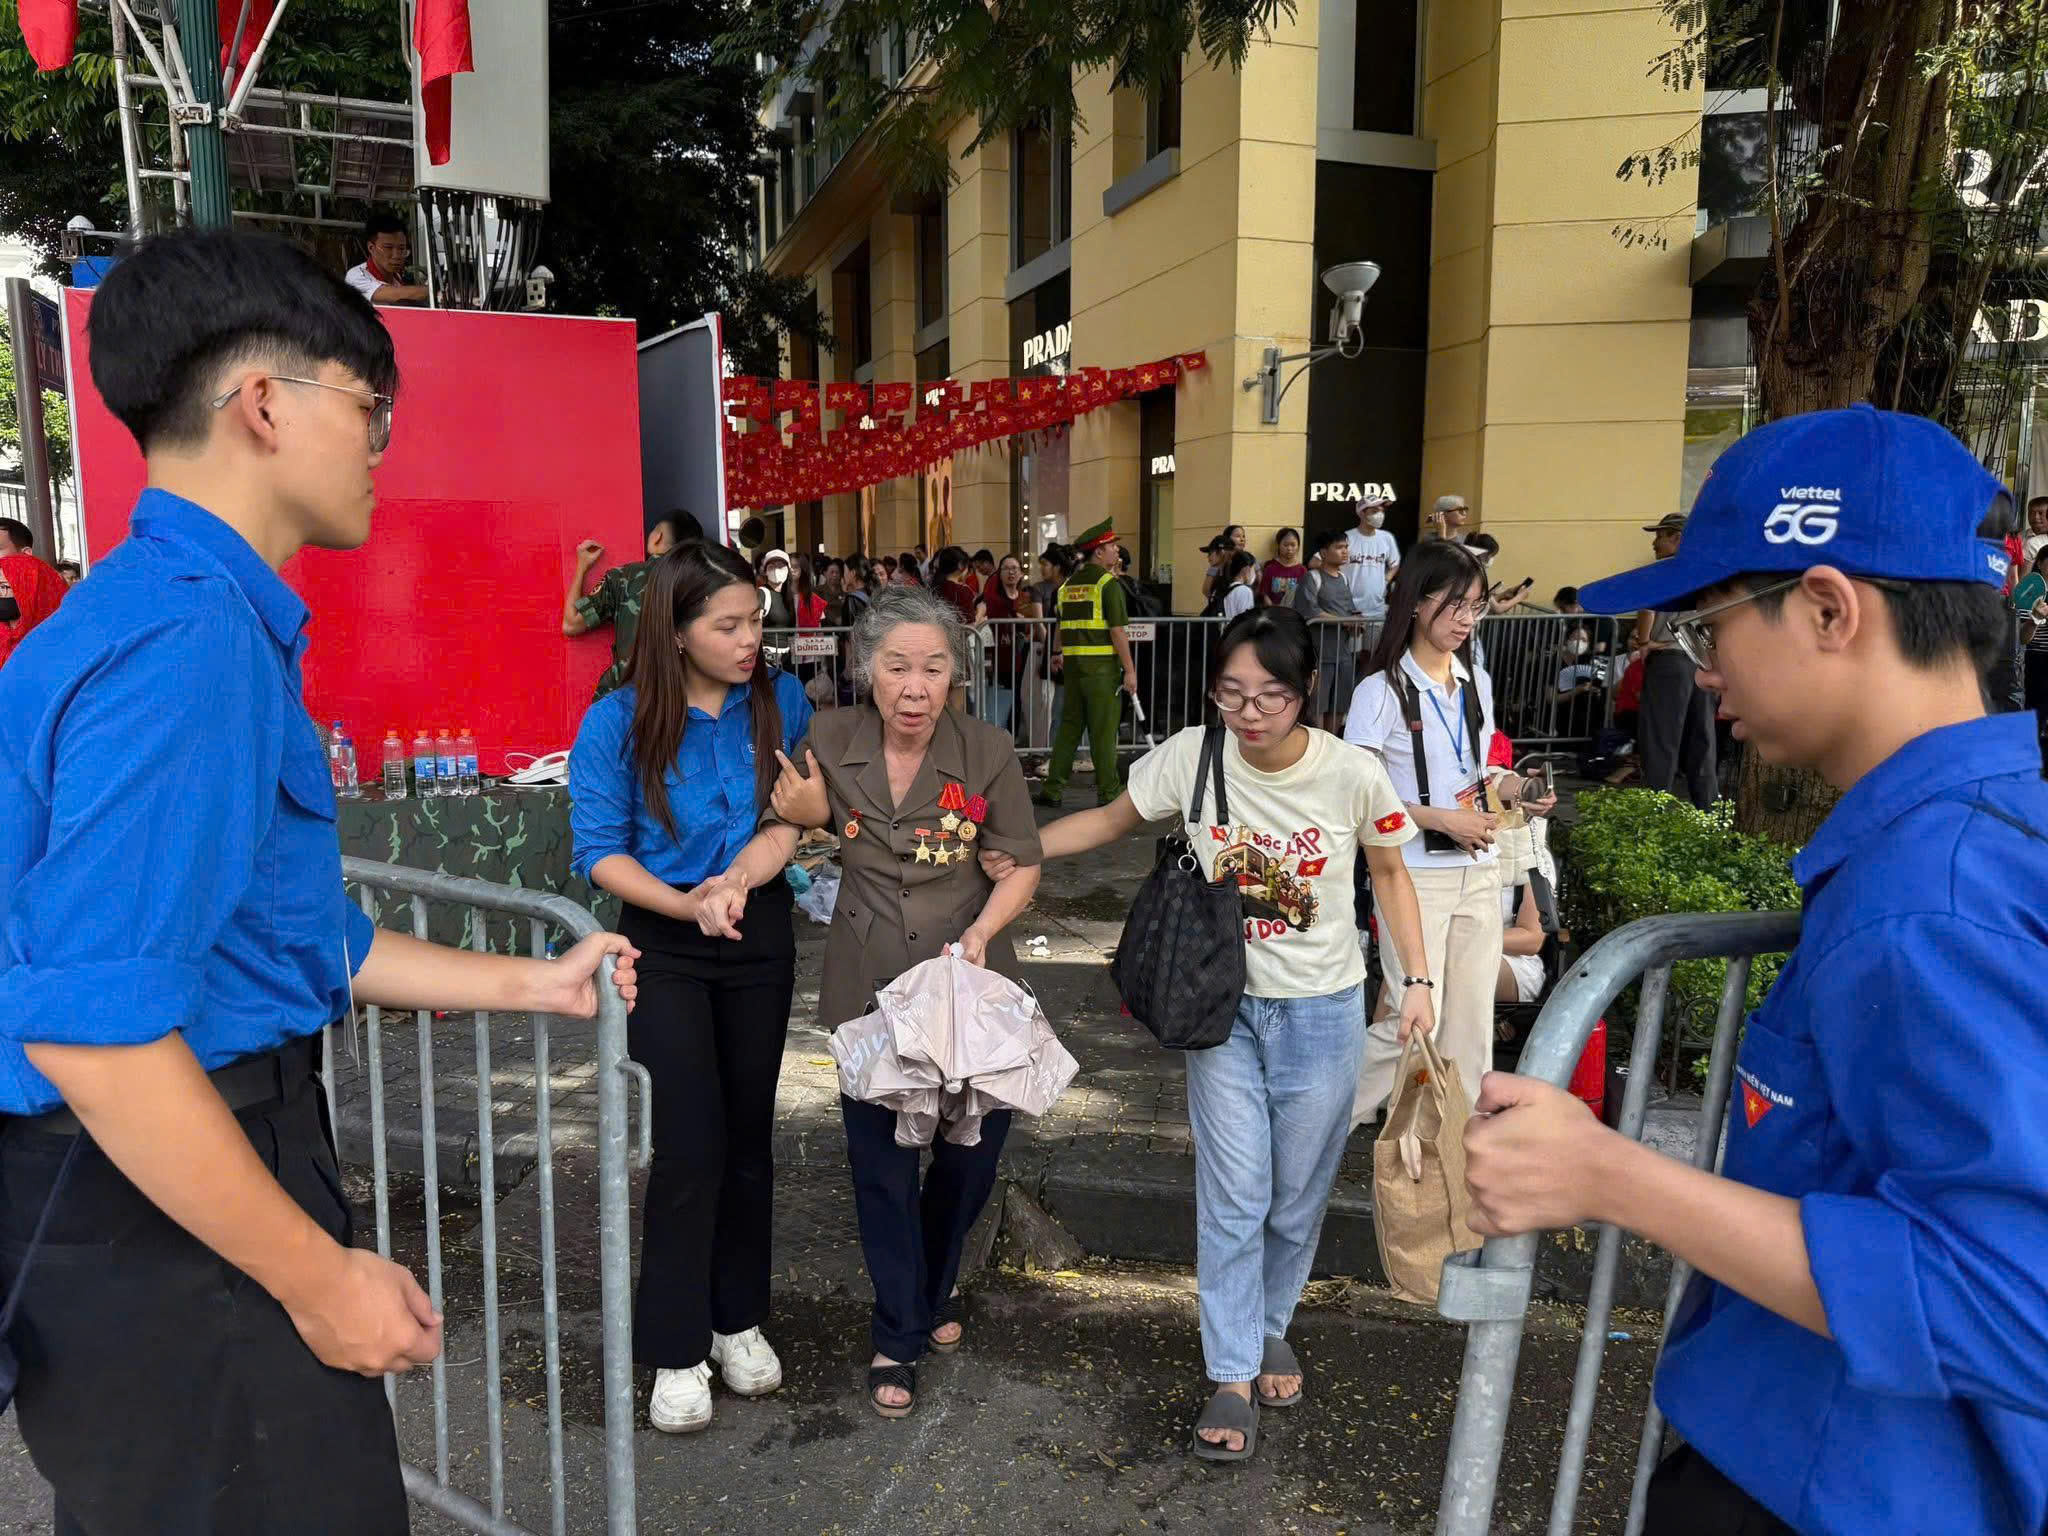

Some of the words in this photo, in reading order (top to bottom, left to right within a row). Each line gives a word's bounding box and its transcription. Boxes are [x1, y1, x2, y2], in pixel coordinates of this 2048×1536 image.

[1309, 482, 1397, 502] PRADA
[1780, 486, 1841, 501] viettel
[1763, 503, 1840, 545] 5G
[1285, 827, 1322, 857] LẬP
[1256, 918, 1287, 940] DO
[1770, 1090, 1794, 1107] NAM
